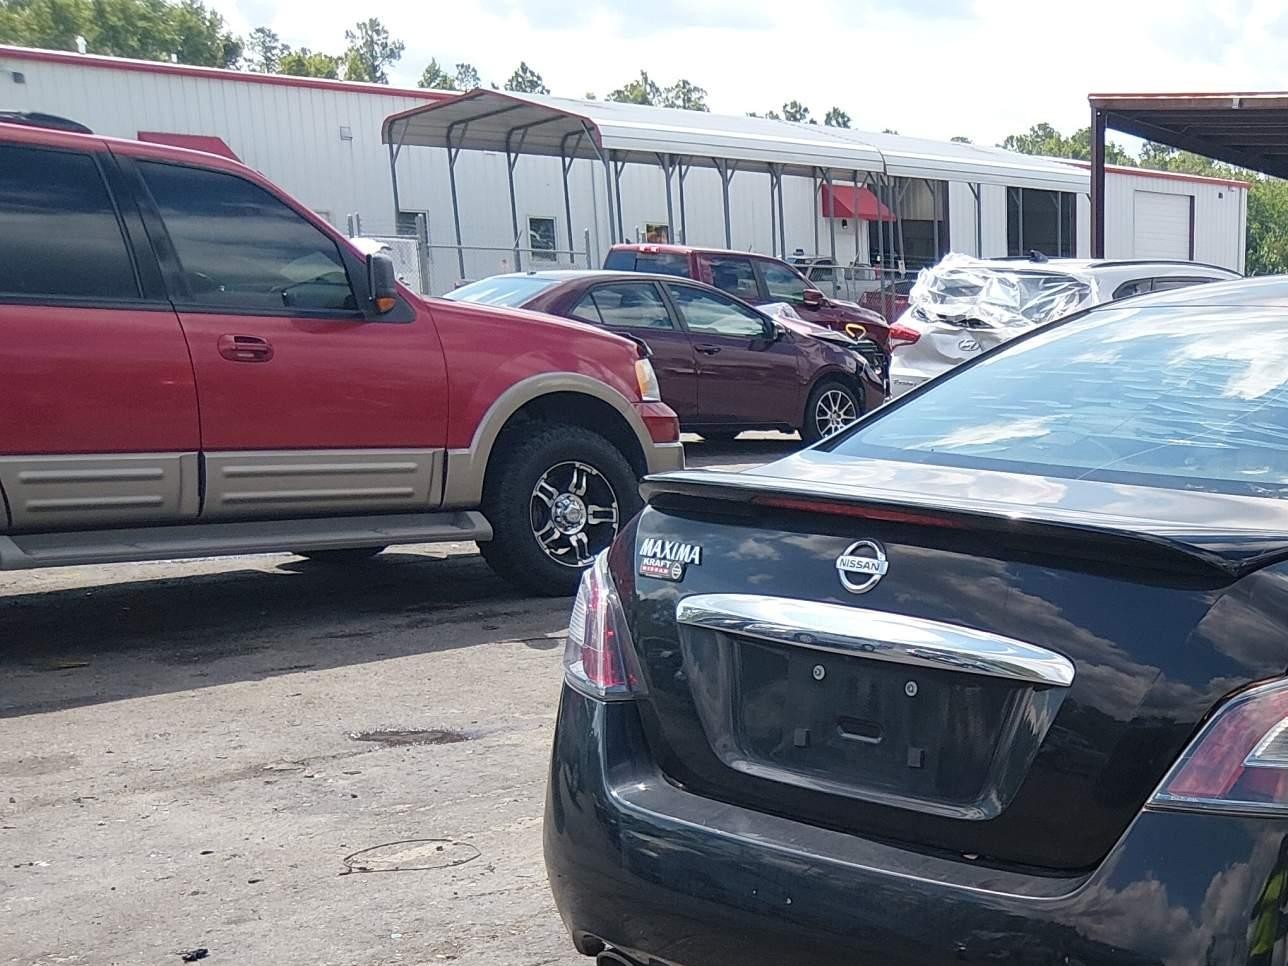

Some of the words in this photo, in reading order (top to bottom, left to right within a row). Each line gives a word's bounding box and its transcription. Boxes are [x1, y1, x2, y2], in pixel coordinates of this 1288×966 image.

[640, 538, 700, 565] MAXIMA
[643, 558, 672, 568] KRAFT
[840, 558, 879, 571] NISSAN
